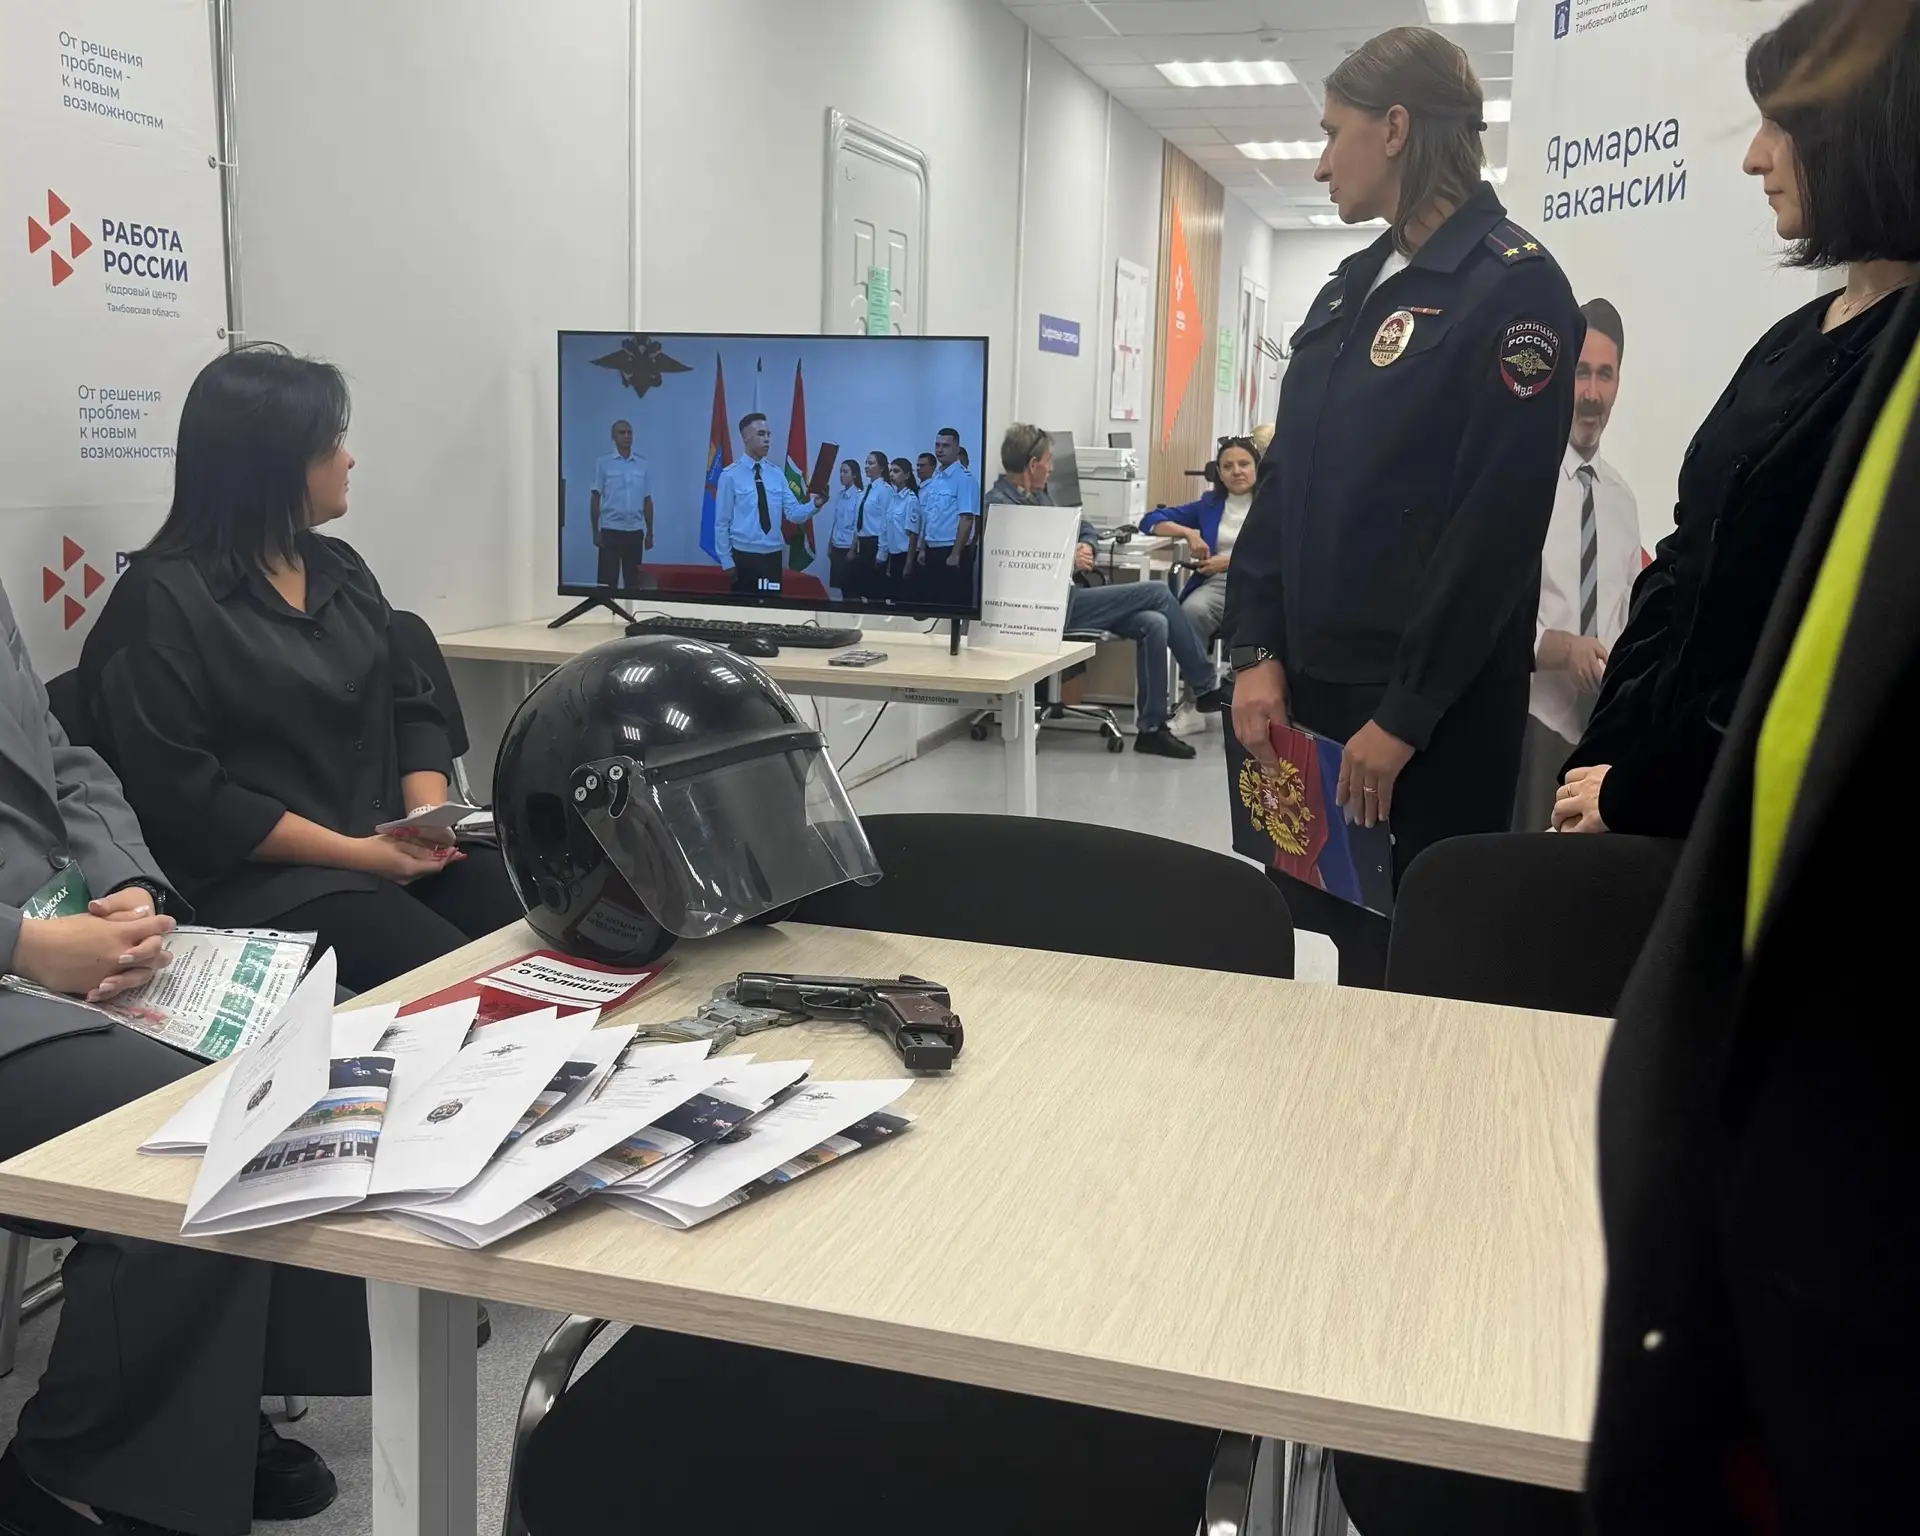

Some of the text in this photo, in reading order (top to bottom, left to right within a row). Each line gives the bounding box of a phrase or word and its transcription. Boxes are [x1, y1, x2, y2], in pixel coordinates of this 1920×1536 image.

[1576, 2, 1611, 20] занятости
[1576, 12, 1617, 34] Тамбовской
[1618, 4, 1648, 20] области
[59, 31, 144, 68] От решения
[61, 53, 123, 82] проблем
[74, 78, 121, 100] новым
[63, 95, 164, 130] возможностям
[1546, 117, 1680, 179] Ярмарка
[1543, 159, 1687, 222] вакансий
[102, 218, 184, 253] РАБОТА
[104, 249, 189, 283] РОССИИ
[105, 283, 178, 302] Кадровый центр
[107, 302, 181, 319] Тамбовская область
[1507, 323, 1559, 347] ПОЛИЦИЯ
[1508, 335, 1554, 357] РОССИЯ
[78, 384, 161, 404] От решения
[1513, 382, 1533, 397] МВД
[79, 404, 140, 422] проблем
[91, 427, 137, 439] новым
[990, 549, 1016, 558] ОМВД
[1017, 550, 1051, 559] РОССИИ
[1008, 561, 1053, 571] КОТОВСКУ
[521, 962, 635, 989] ФЕДЕРАЛЬНЫЙ ЗАКОН
[533, 973, 621, 994] ПОЛИЦИИ»
